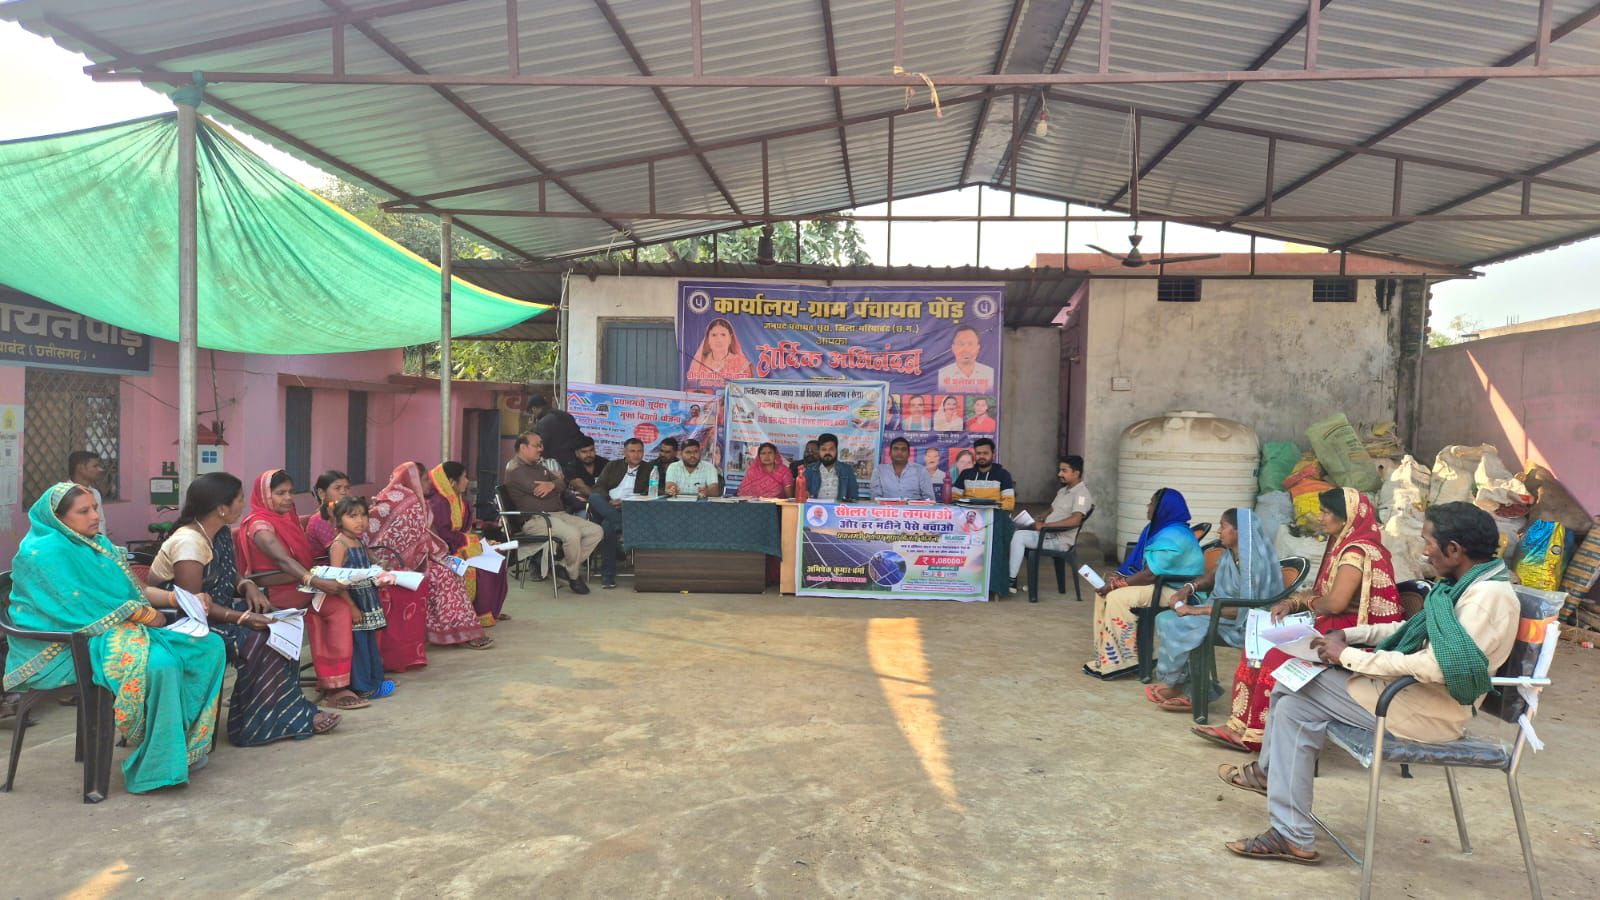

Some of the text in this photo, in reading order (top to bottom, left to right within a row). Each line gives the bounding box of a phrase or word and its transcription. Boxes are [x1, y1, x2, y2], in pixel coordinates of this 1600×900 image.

[853, 296, 922, 319] पंचायत
[815, 337, 848, 345] आपका
[756, 340, 923, 377] हार्दिक अभिनंदन
[835, 505, 953, 520] सोलर प्लांट लगवाओ
[861, 521, 873, 529] हर
[876, 520, 901, 530] महीने
[903, 520, 920, 531] पैसे
[922, 522, 954, 532] बचाओ
